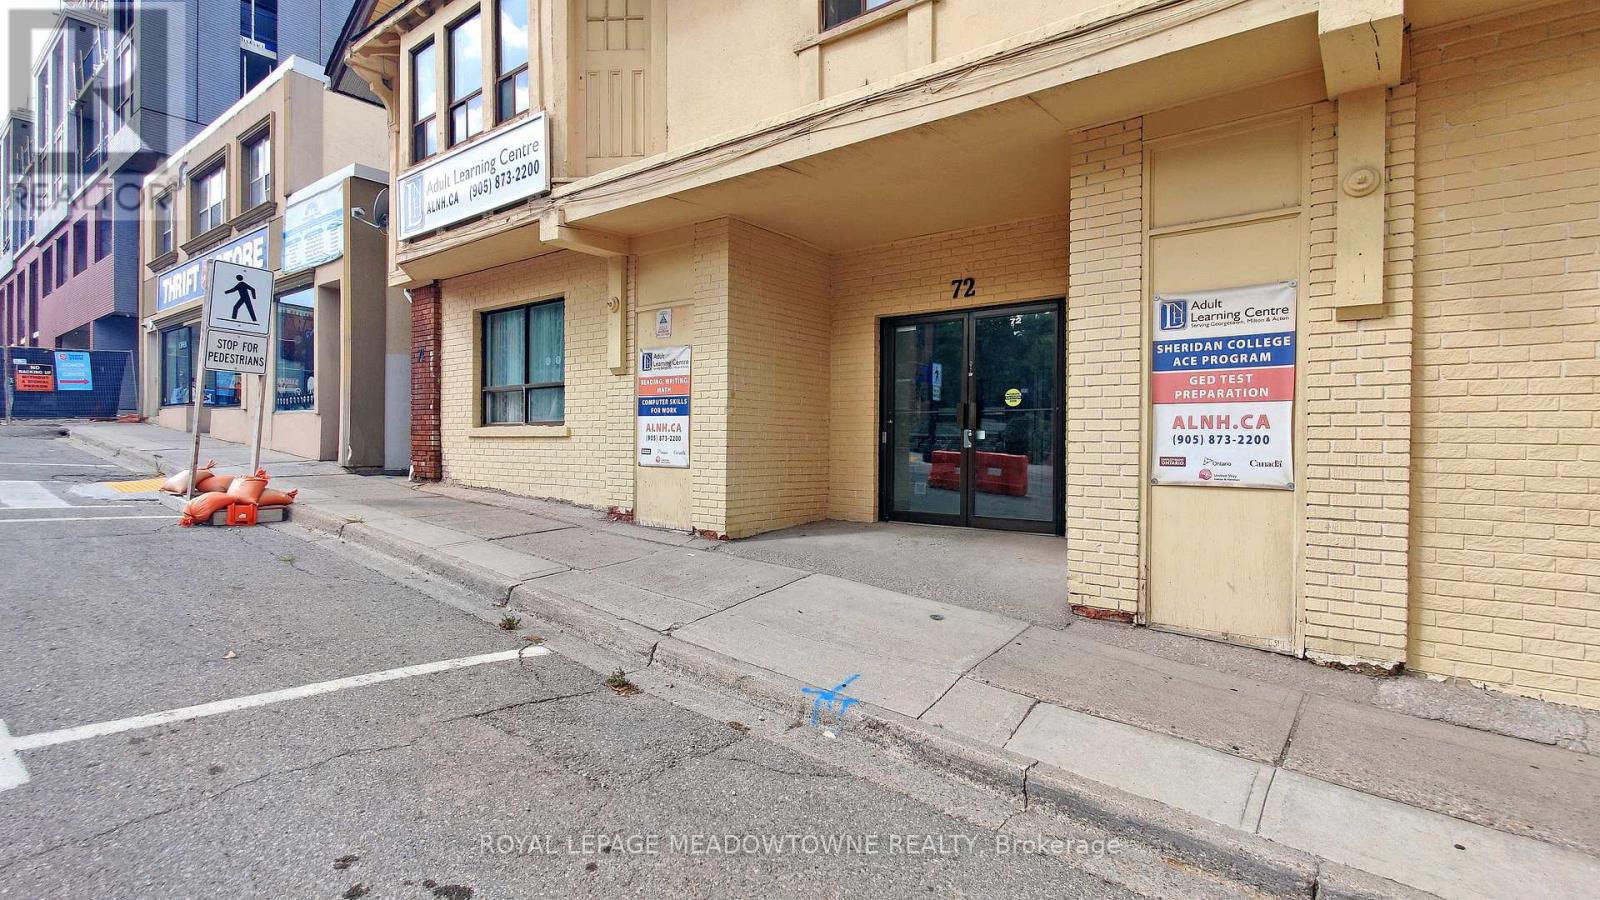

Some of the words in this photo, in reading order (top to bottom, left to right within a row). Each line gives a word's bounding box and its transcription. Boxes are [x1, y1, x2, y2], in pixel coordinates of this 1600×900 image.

[426, 173, 451, 195] Adult
[454, 158, 497, 184] Learning
[500, 140, 539, 165] Centre
[426, 191, 460, 215] ALNH.CA
[469, 177, 493, 202] (905)
[495, 159, 540, 189] 873-2200
[162, 263, 200, 305] THRIFT
[216, 236, 264, 269] ORE
[951, 277, 976, 299] 72
[1191, 299, 1223, 311] Adult
[1191, 310, 1241, 323] Learning
[1244, 306, 1289, 318] Centre
[217, 338, 239, 351] STOP
[242, 342, 259, 353] FOR
[1157, 340, 1223, 354] SHERIDAN
[1227, 336, 1291, 349] COLLEGE
[207, 351, 265, 367] PEDESTRIANS
[653, 360, 671, 368] Learning
[1173, 355, 1198, 367] ACE
[1202, 352, 1271, 365] PROGRAM
[665, 377, 688, 385] WRITING
[1189, 375, 1216, 386] GED
[1220, 374, 1253, 385] TEST
[1174, 387, 1269, 400] PREPARATION
[646, 423, 682, 432] ALNH.CA
[1172, 414, 1271, 430] ALNH.CA
[1172, 434, 1204, 446] (905)
[1208, 434, 1270, 445] 873-2200
